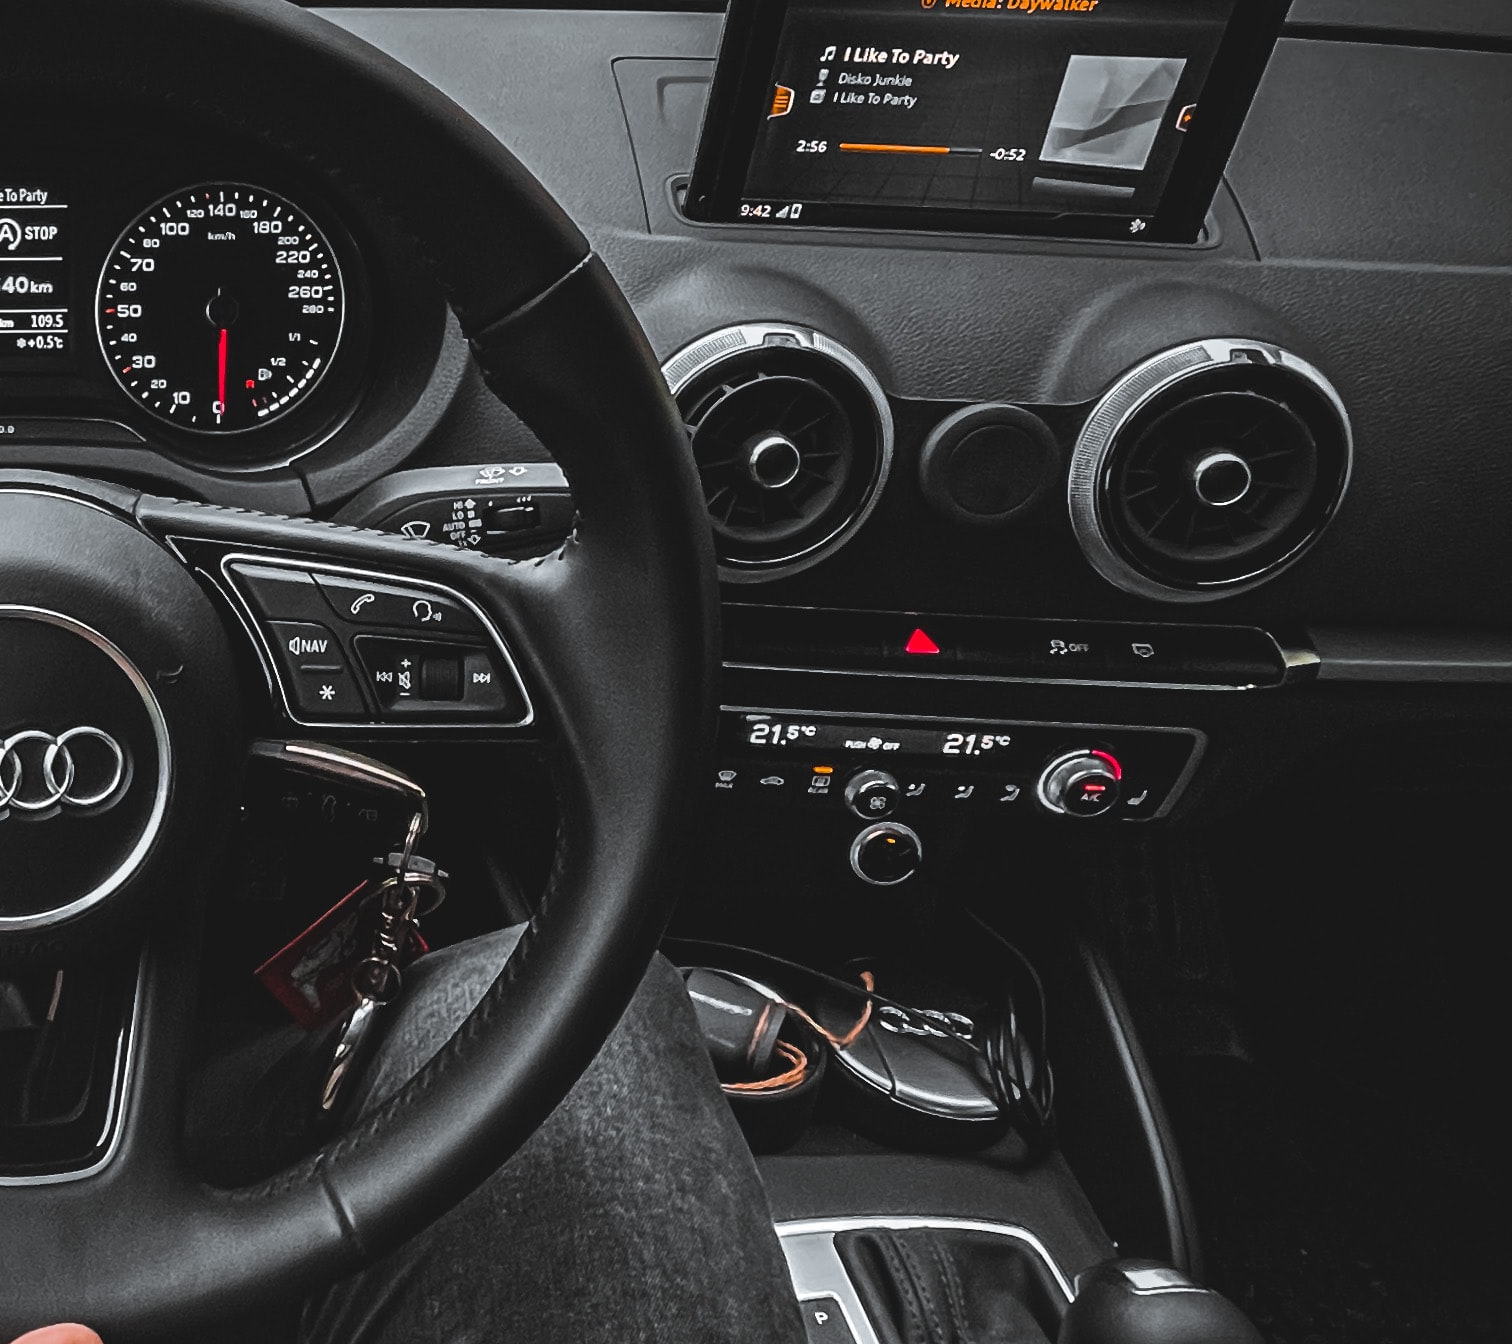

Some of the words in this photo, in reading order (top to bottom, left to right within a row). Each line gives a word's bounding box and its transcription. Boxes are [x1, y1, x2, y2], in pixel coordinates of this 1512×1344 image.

[853, 47, 888, 63] Like
[891, 48, 910, 64] To
[913, 49, 960, 69] Party
[838, 72, 872, 85] Disko
[872, 73, 913, 87] Junkie
[840, 91, 865, 104] Like
[867, 92, 881, 104] To
[883, 93, 918, 109] Party
[796, 140, 828, 154] 2:56
[989, 147, 1027, 161] -0:52
[4, 188, 18, 202] To
[19, 188, 48, 205] Party
[207, 203, 237, 217] 140
[740, 203, 772, 218] 9:42
[24, 225, 58, 241] STOP
[159, 221, 190, 236] 100
[252, 220, 282, 234] 180
[207, 231, 236, 242] km/h
[277, 236, 300, 246] 200
[275, 250, 311, 264] 220
[129, 257, 155, 272] 70
[296, 269, 319, 279] 240
[119, 282, 137, 292] 60
[287, 285, 323, 299] 260
[116, 304, 142, 318] 50
[30, 314, 64, 328] 109.5
[120, 333, 138, 343] 40
[131, 355, 156, 369] 30
[270, 357, 286, 367] 1/2
[150, 379, 167, 389] 20
[172, 391, 191, 405] 10
[442, 521, 466, 532] AUTO
[449, 530, 466, 540] OFF
[300, 639, 328, 653] NAV
[1068, 643, 1090, 652] OFF
[814, 1311, 829, 1325] P
